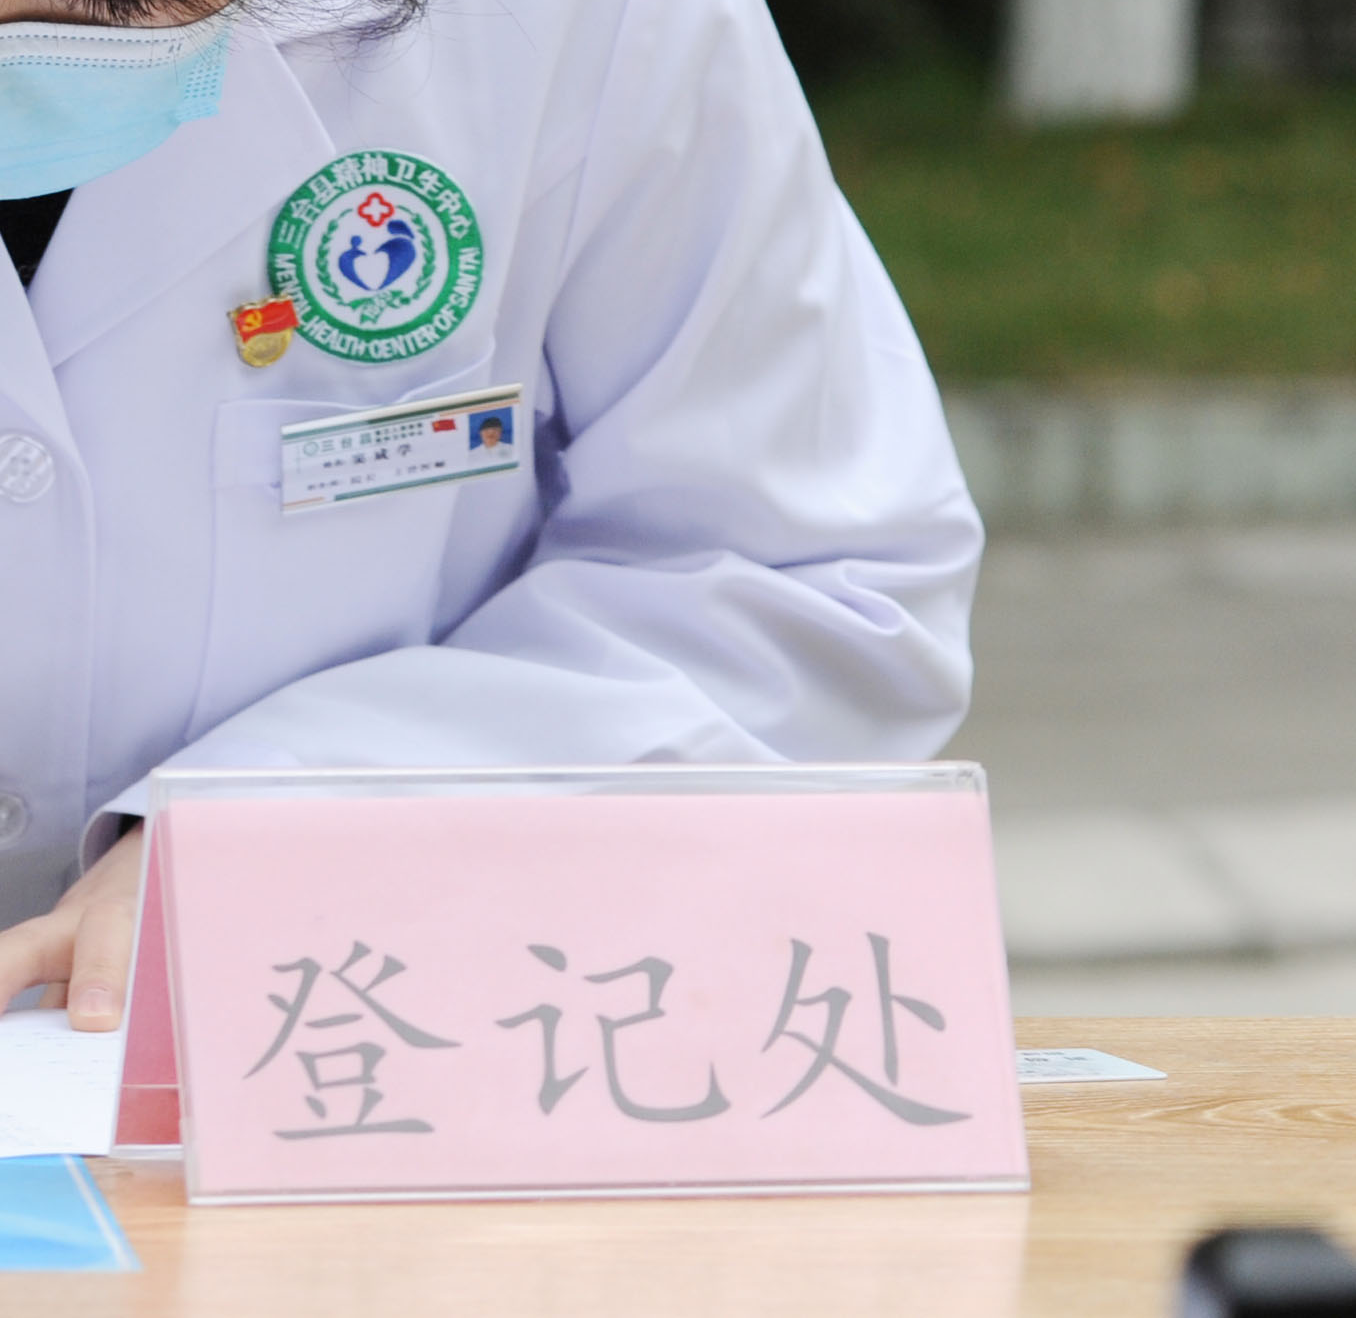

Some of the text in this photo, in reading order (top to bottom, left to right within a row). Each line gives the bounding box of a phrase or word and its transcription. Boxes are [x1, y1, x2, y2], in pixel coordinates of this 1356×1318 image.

[278, 154, 469, 249] 三台县精神卫生中心
[303, 315, 366, 356] HEALTH
[369, 324, 441, 359] CENTER
[432, 304, 459, 332] OF
[449, 247, 481, 308] SANTAI
[245, 932, 971, 1141] 登记处
